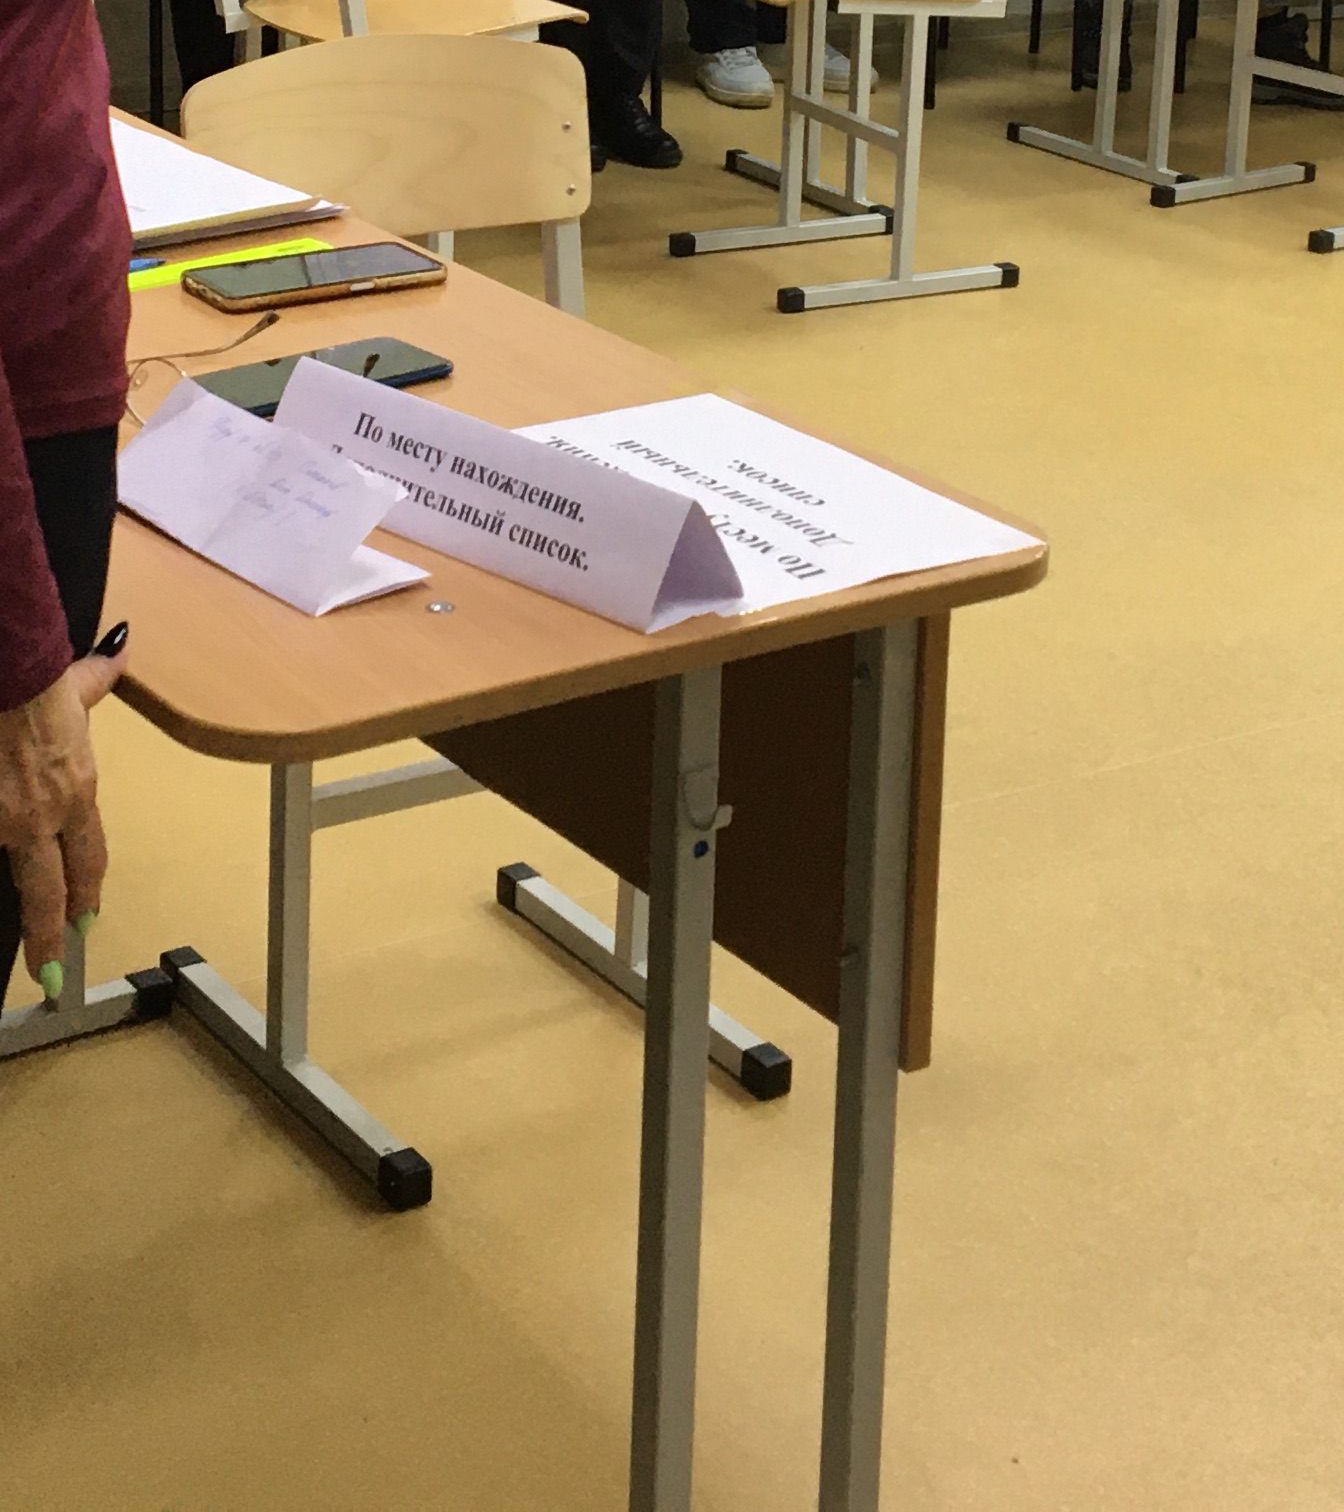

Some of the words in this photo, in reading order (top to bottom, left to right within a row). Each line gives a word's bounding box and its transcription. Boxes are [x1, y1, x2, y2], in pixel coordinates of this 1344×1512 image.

[354, 410, 384, 444] По
[388, 431, 448, 472] месту
[450, 456, 586, 523] нахождения.
[610, 438, 855, 548] Дополнительный
[508, 522, 589, 572] список.
[777, 555, 827, 581] По
